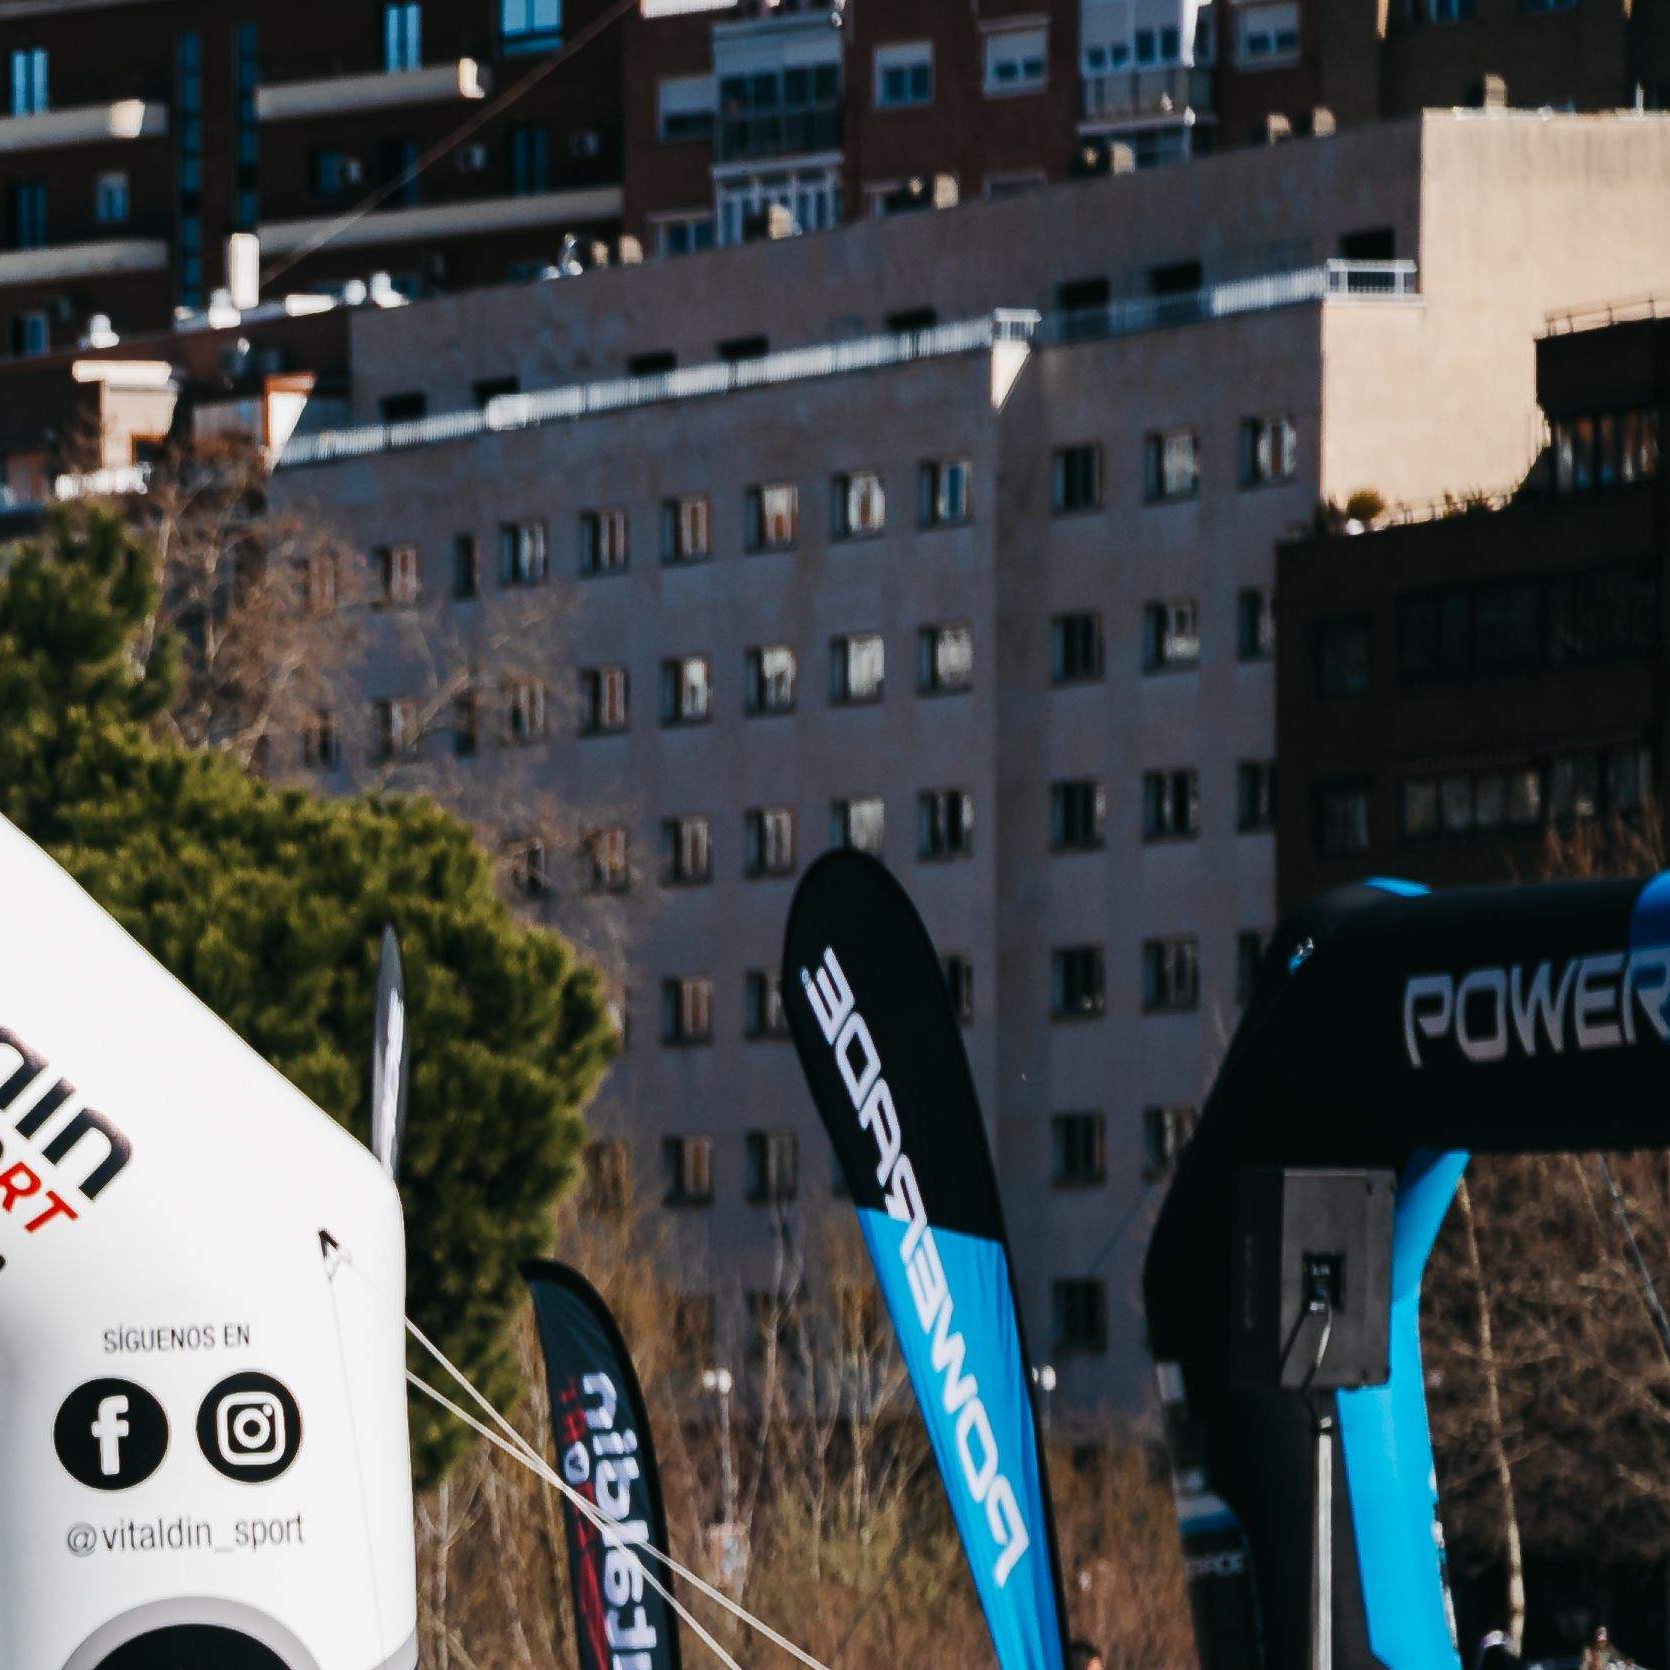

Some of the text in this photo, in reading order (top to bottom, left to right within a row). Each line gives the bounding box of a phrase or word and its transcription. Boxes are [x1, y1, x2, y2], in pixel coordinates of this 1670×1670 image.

[102, 1323, 251, 1353] SÍGUENOS EN
[66, 1513, 306, 1558] @vitaldin_sport
